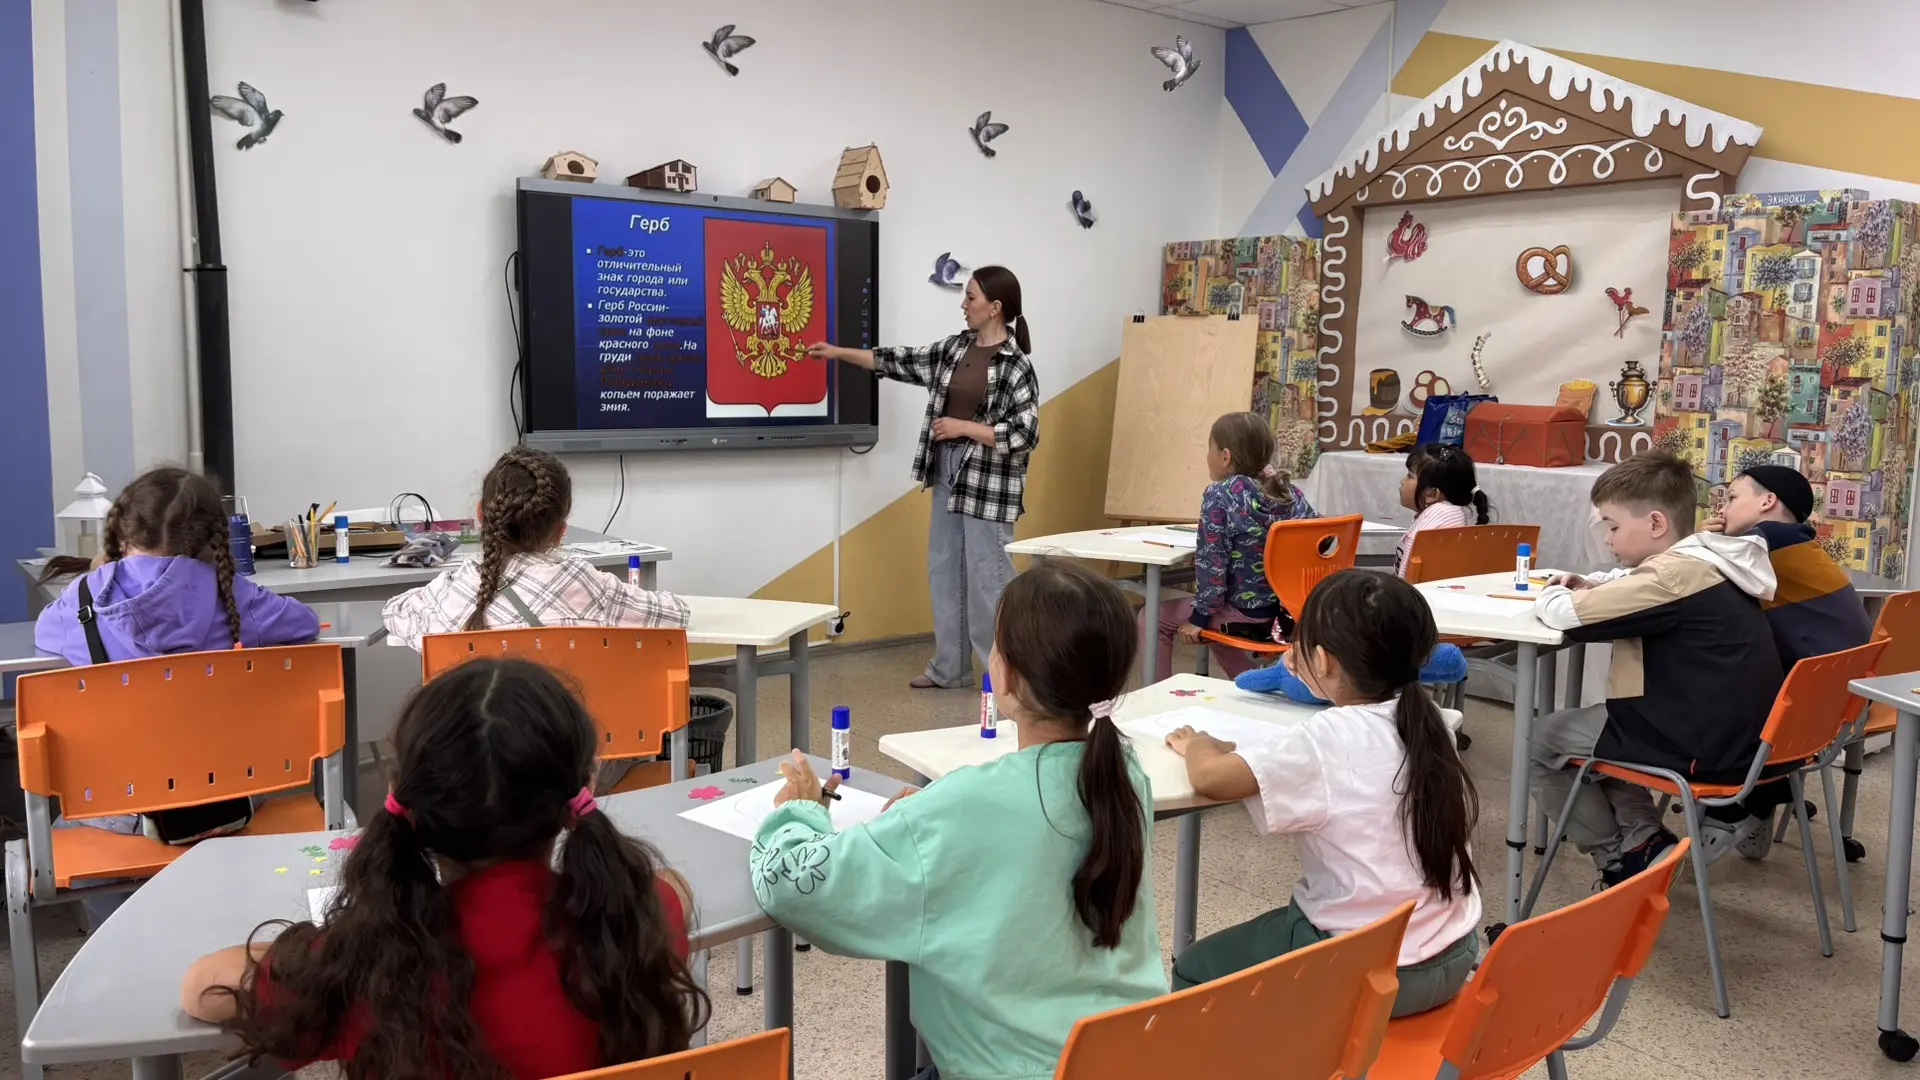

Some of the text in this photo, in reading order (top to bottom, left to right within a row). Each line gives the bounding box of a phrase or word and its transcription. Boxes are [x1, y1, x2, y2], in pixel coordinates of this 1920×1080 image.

[1767, 194, 1806, 205] ЭКИВОКИ
[629, 214, 670, 234] Герб
[597, 260, 682, 273] отличительный
[597, 273, 688, 285] знак города или
[597, 286, 667, 298] государства.
[598, 300, 670, 312] Герб России-
[598, 314, 642, 324] золотой
[629, 328, 642, 336] на
[646, 327, 674, 338] фоне
[599, 341, 649, 350] красного
[599, 353, 631, 363] груди
[600, 390, 695, 400] копьем поражает
[600, 404, 631, 412] змия.
